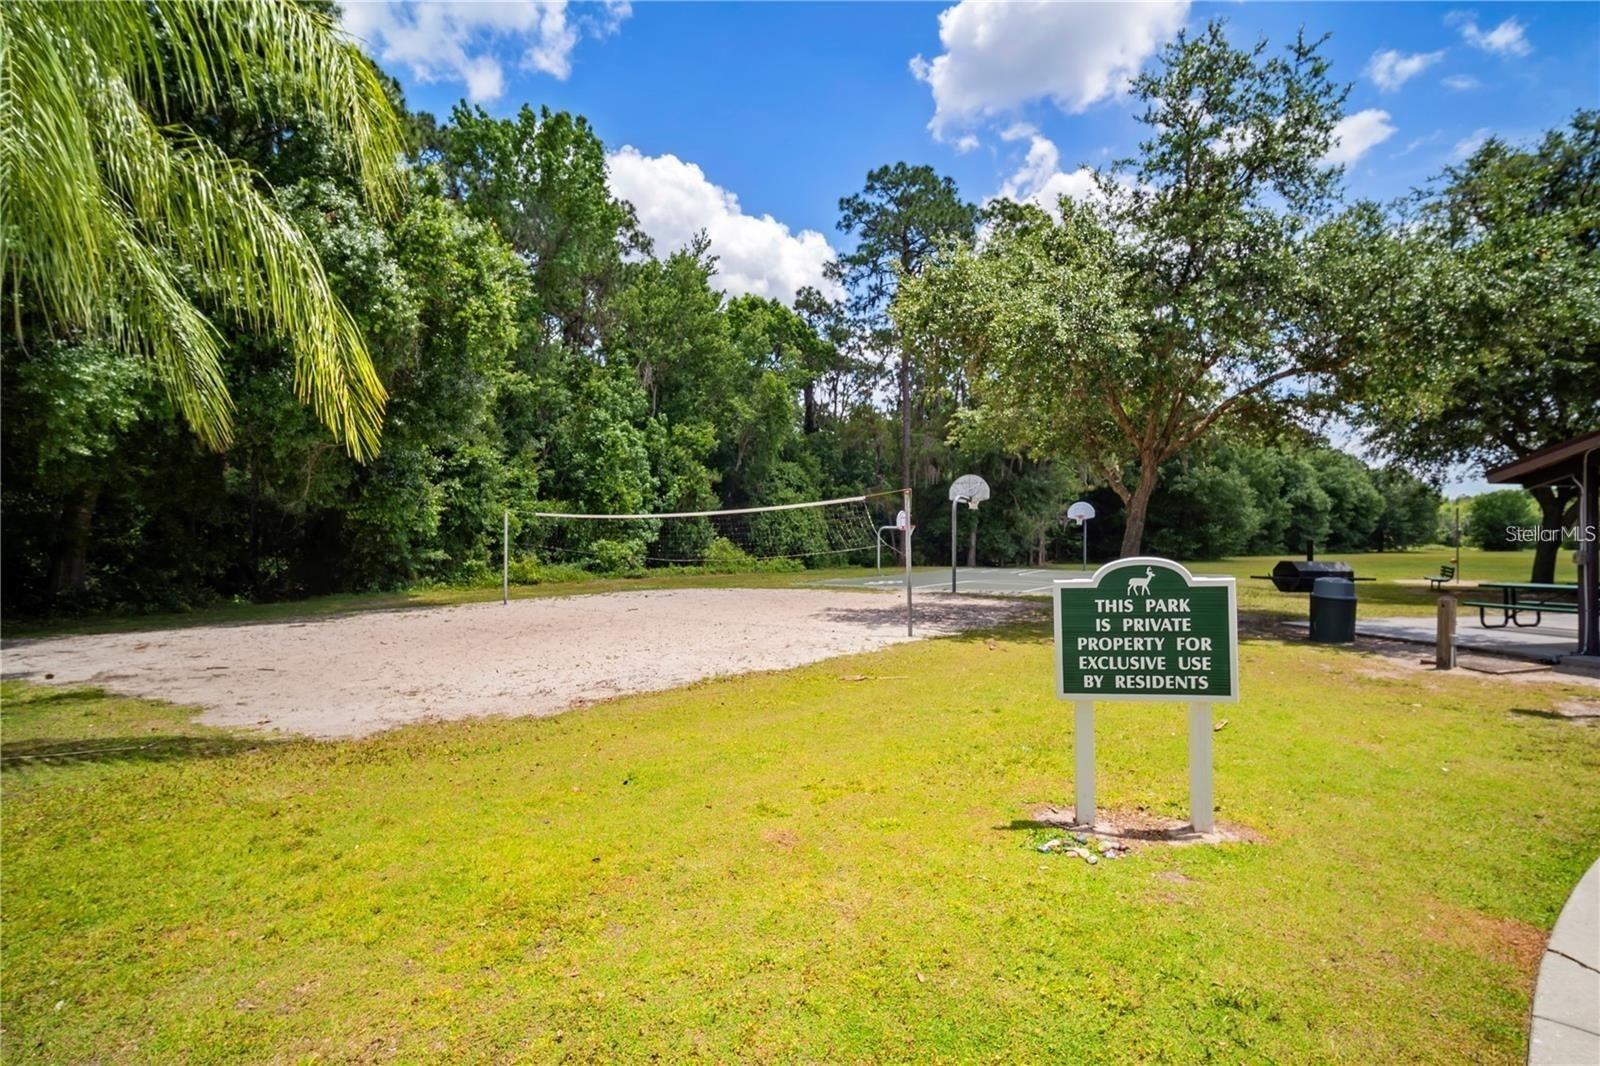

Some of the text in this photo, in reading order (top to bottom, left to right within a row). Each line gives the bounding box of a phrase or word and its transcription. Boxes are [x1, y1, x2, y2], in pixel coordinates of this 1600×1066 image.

[1095, 598, 1191, 613] THIS PARK
[1095, 617, 1192, 632] IS PRIVATE
[1077, 637, 1212, 651] PROPERTY FOR
[1078, 656, 1212, 671] EXCLUSIVE USE
[1083, 675, 1209, 689] BY RESIDENTS
